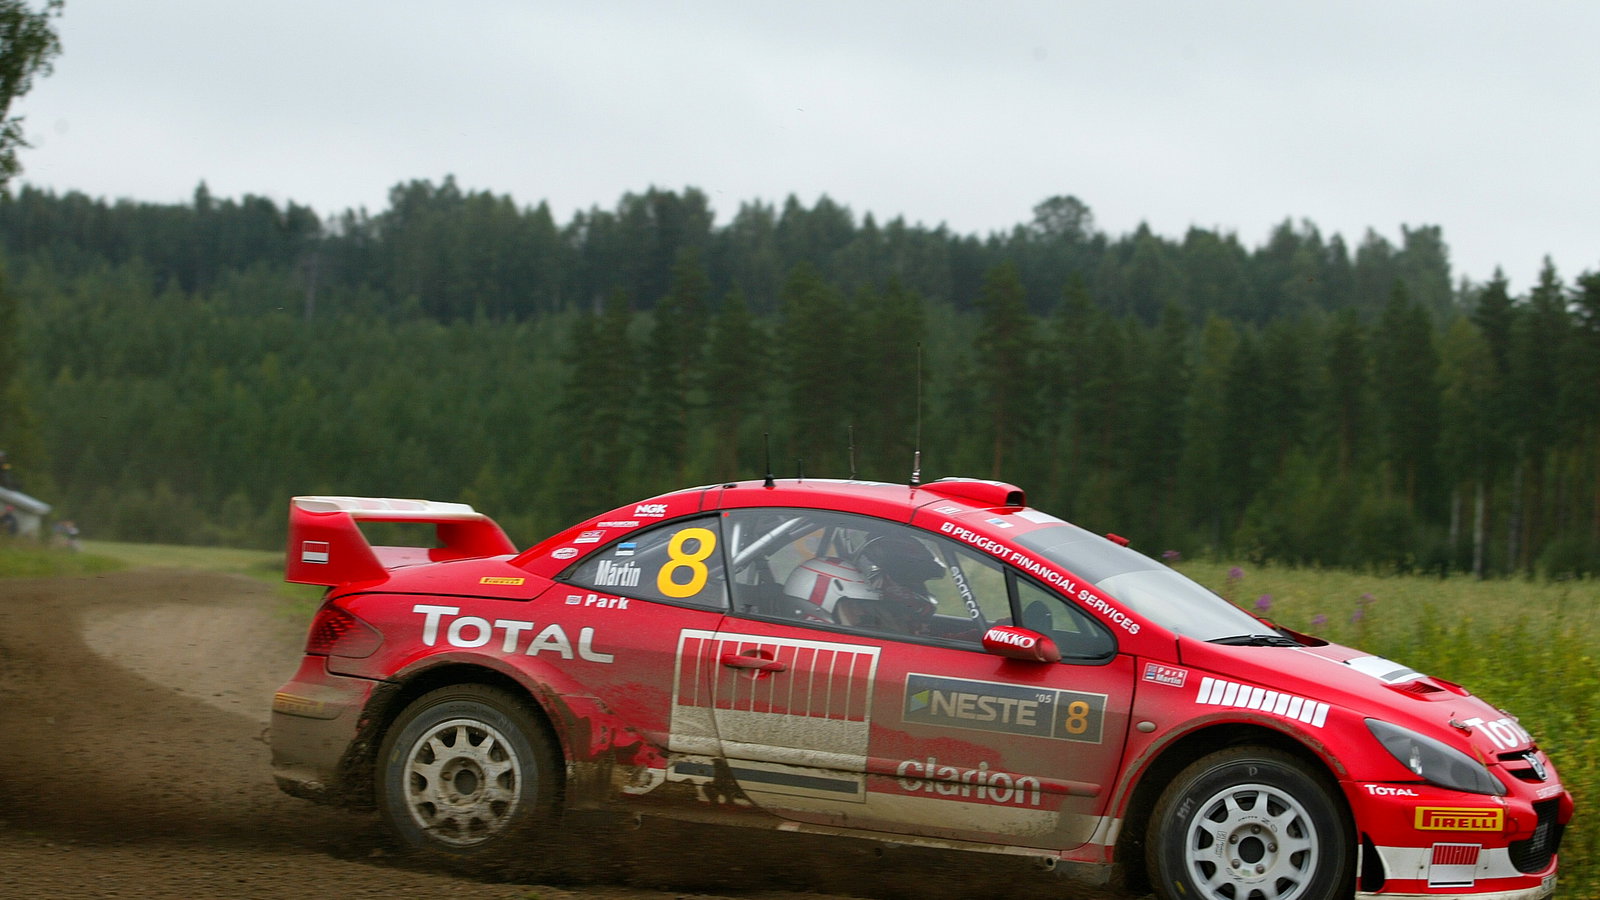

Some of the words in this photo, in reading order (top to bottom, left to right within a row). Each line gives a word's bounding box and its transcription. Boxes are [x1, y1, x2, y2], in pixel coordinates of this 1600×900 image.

[635, 504, 668, 513] NGK
[657, 527, 717, 599] 8
[952, 527, 1013, 558] PEUGEOT
[1010, 552, 1076, 595] FINANCIAL
[1077, 589, 1141, 636] SERVICES
[584, 594, 630, 609] Park
[983, 629, 1036, 649] NIKKO
[930, 690, 1040, 726] NESTE
[1064, 700, 1090, 735] 8
[897, 757, 1041, 806] clarion
[1364, 784, 1419, 797] TOTAL
[1422, 809, 1498, 829] PIRELLI
